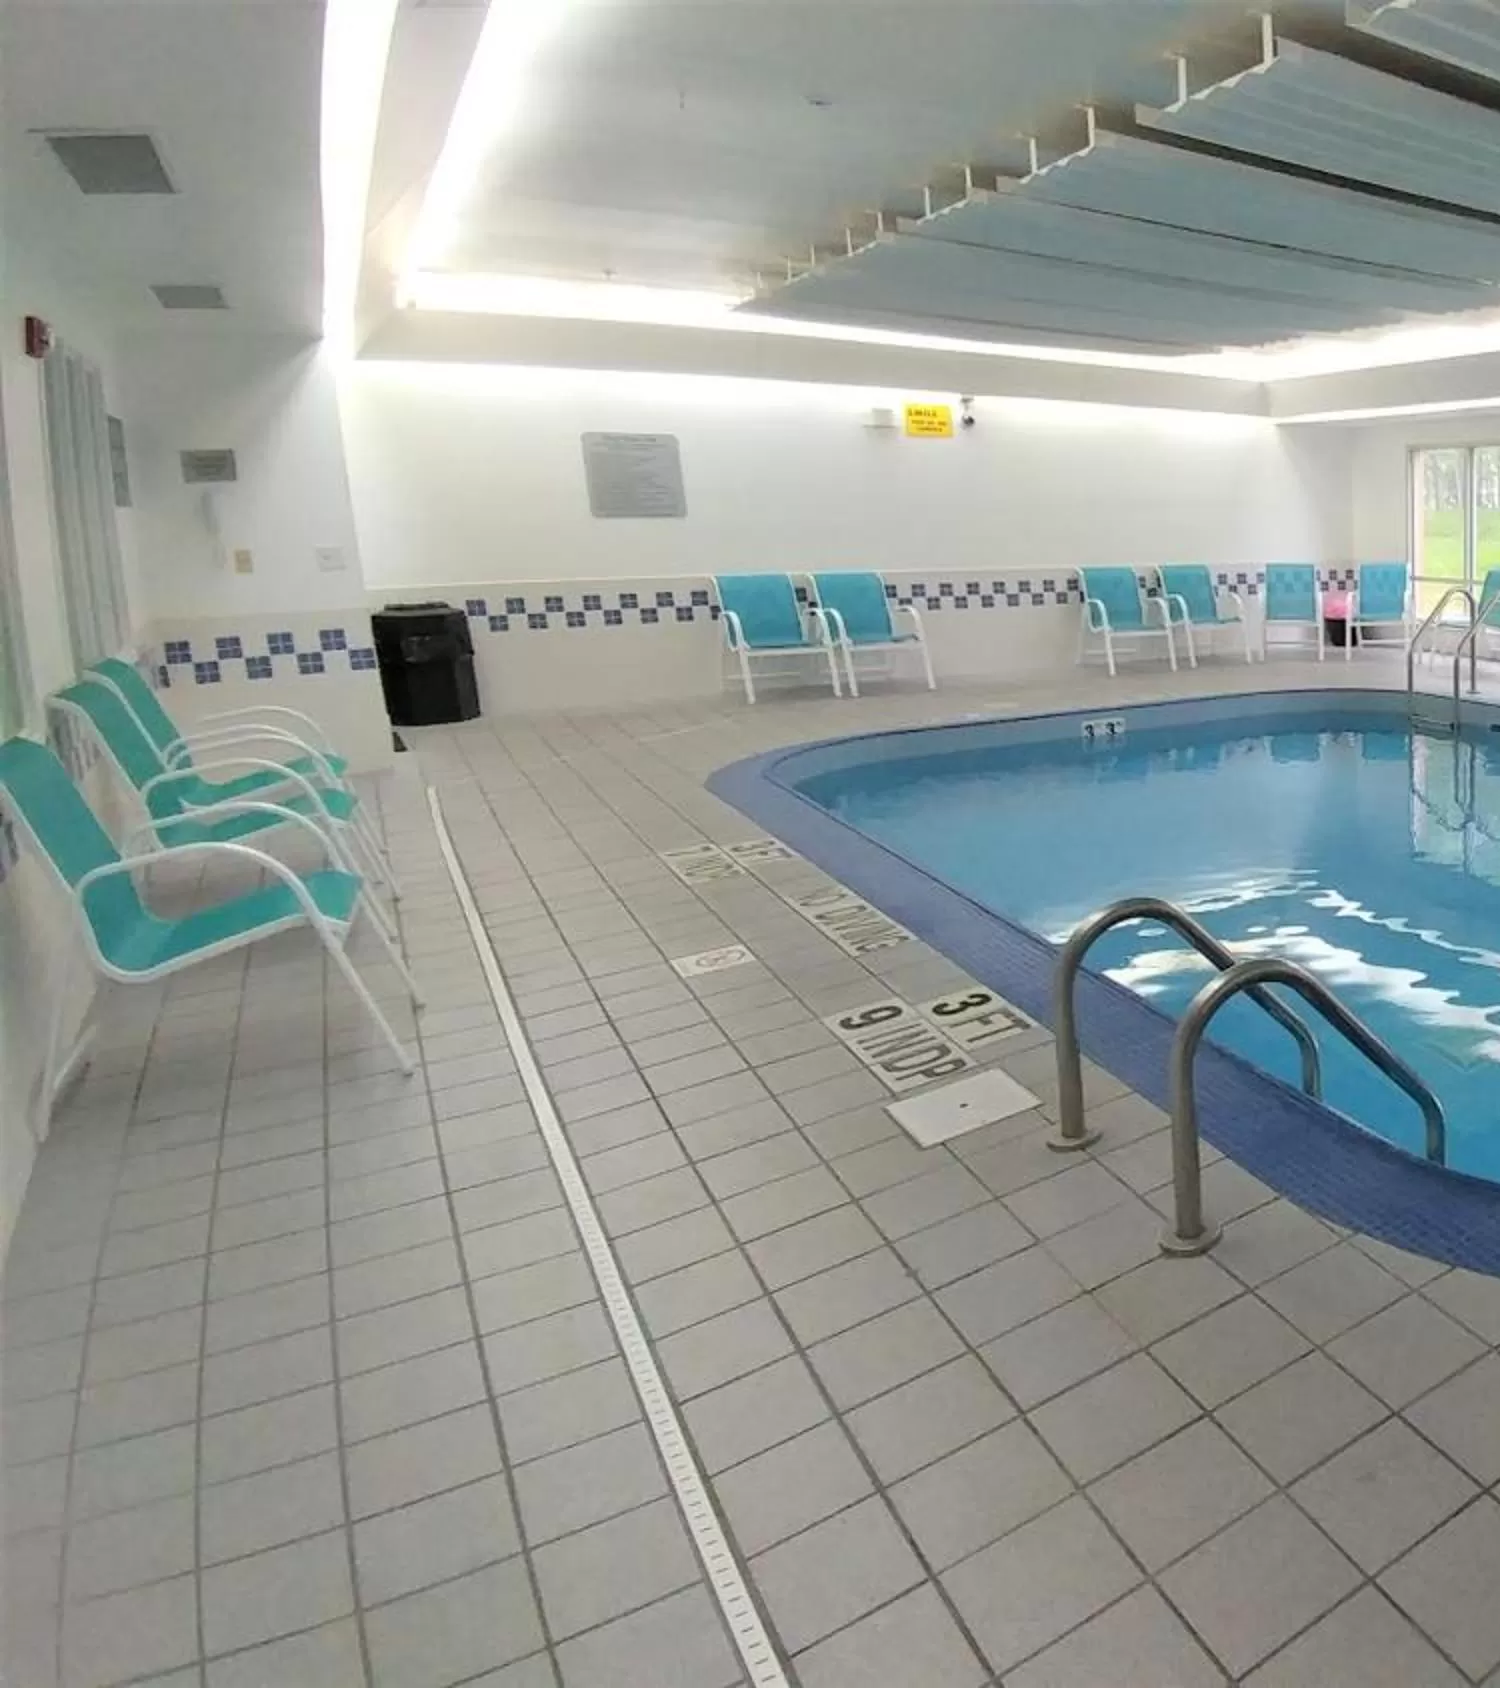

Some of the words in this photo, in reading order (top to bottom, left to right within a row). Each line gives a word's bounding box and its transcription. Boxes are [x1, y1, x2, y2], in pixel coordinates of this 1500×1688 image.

[932, 993, 992, 1017] 3
[839, 1006, 903, 1030] 9
[950, 1009, 1033, 1043] FT
